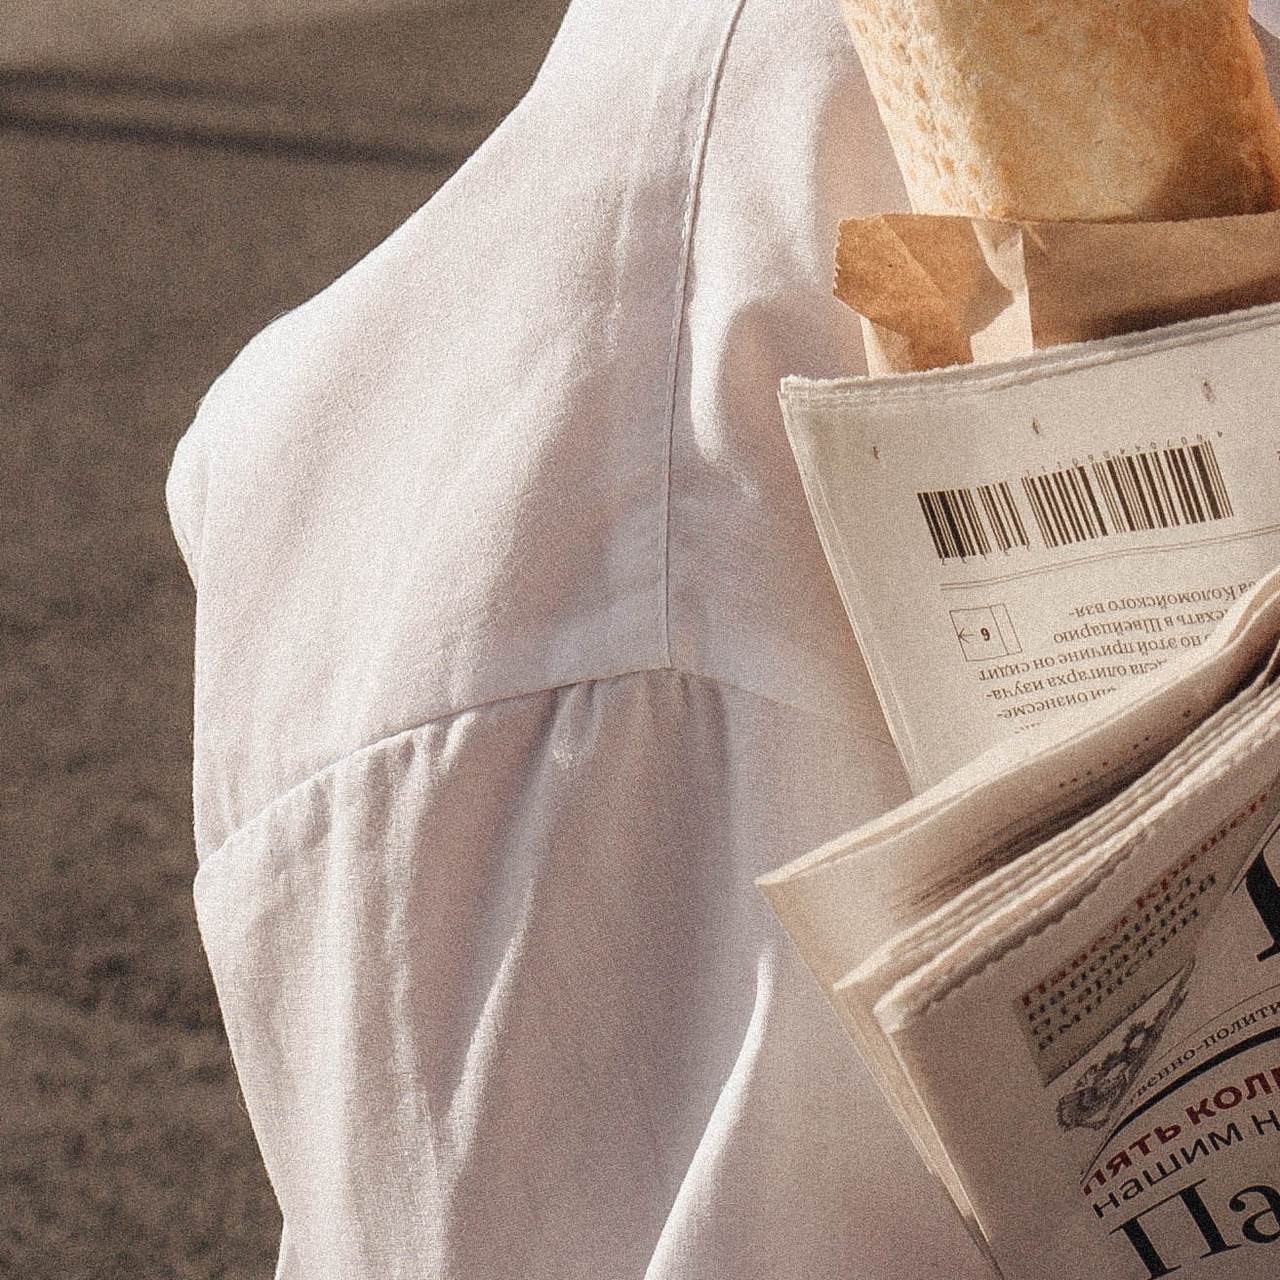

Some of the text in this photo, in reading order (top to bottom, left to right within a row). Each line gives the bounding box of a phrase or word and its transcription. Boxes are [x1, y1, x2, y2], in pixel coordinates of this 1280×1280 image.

[1069, 585, 1237, 619] Коломойского взя-
[980, 627, 991, 642] 6
[1053, 608, 1229, 644] ехать в Швейцарию
[1059, 640, 1135, 665] причине
[1138, 636, 1176, 657] этой
[1181, 634, 1201, 648] по
[979, 663, 1031, 682] сидит
[1033, 656, 1055, 670] он
[1046, 663, 1128, 687] олигарха
[986, 678, 1044, 700] изуча-
[1082, 1122, 1182, 1197] ПЯТЬ
[1091, 1120, 1244, 1220] нашим
